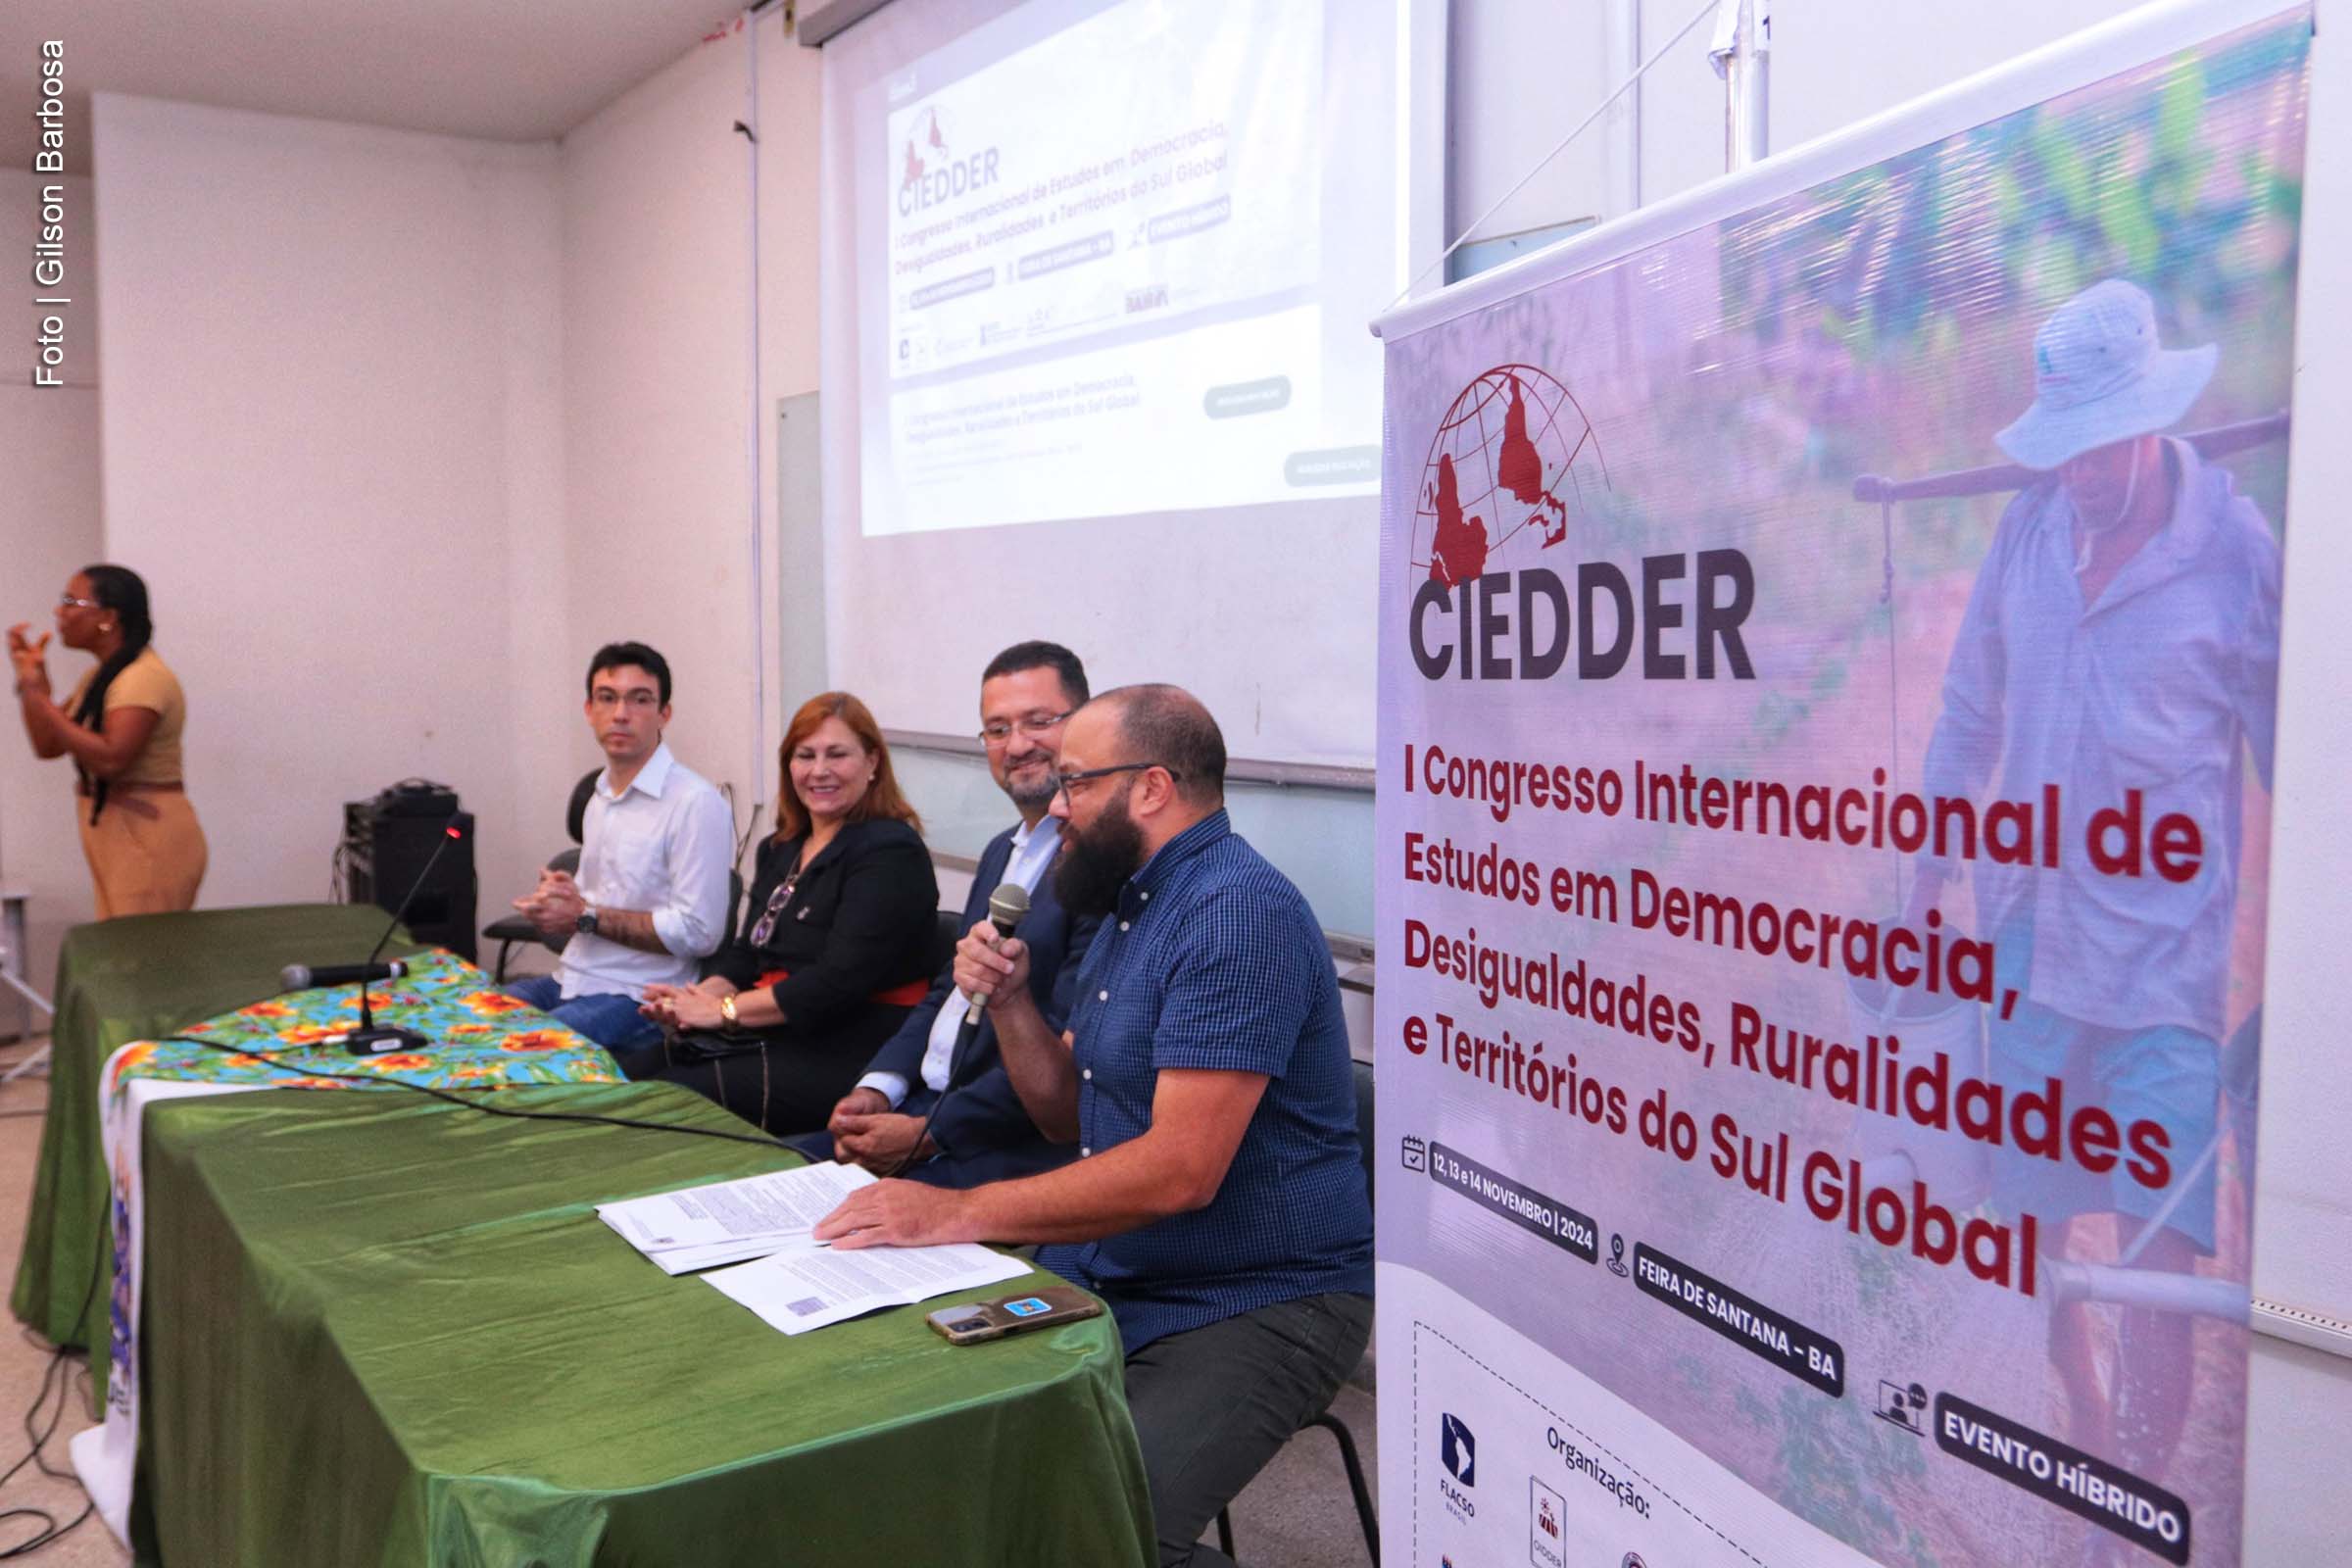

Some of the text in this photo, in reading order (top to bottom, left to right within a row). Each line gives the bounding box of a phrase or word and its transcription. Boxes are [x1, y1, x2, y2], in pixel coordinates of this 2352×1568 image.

[898, 146, 1000, 218] CIEDDER
[1409, 549, 1756, 679] CIEDDER
[1405, 744, 2203, 883] I Congresso Internacional de
[1405, 832, 2019, 1020] Estudos em Democracia,
[1405, 919, 2173, 1190] Desigualdades, Ruralidades
[1403, 1013, 2037, 1298] e Territórios do Sul Global
[1433, 1152, 1447, 1177] 12,
[1448, 1159, 1460, 1181] 13
[1461, 1169, 1469, 1184] e
[1470, 1170, 1482, 1193] 14
[1483, 1178, 1552, 1229] NOVEMBRO
[1561, 1213, 1593, 1250] 2024
[1639, 1255, 1681, 1297] FEIRA
[1684, 1279, 1705, 1308] DE
[1707, 1290, 1790, 1357] SANTANA
[1808, 1340, 1838, 1381] BA
[1440, 1479, 1476, 1518] FLACSO
[1546, 1426, 1651, 1520] Organização:
[1943, 1409, 2182, 1544] EVENTO HÍBRIDO
